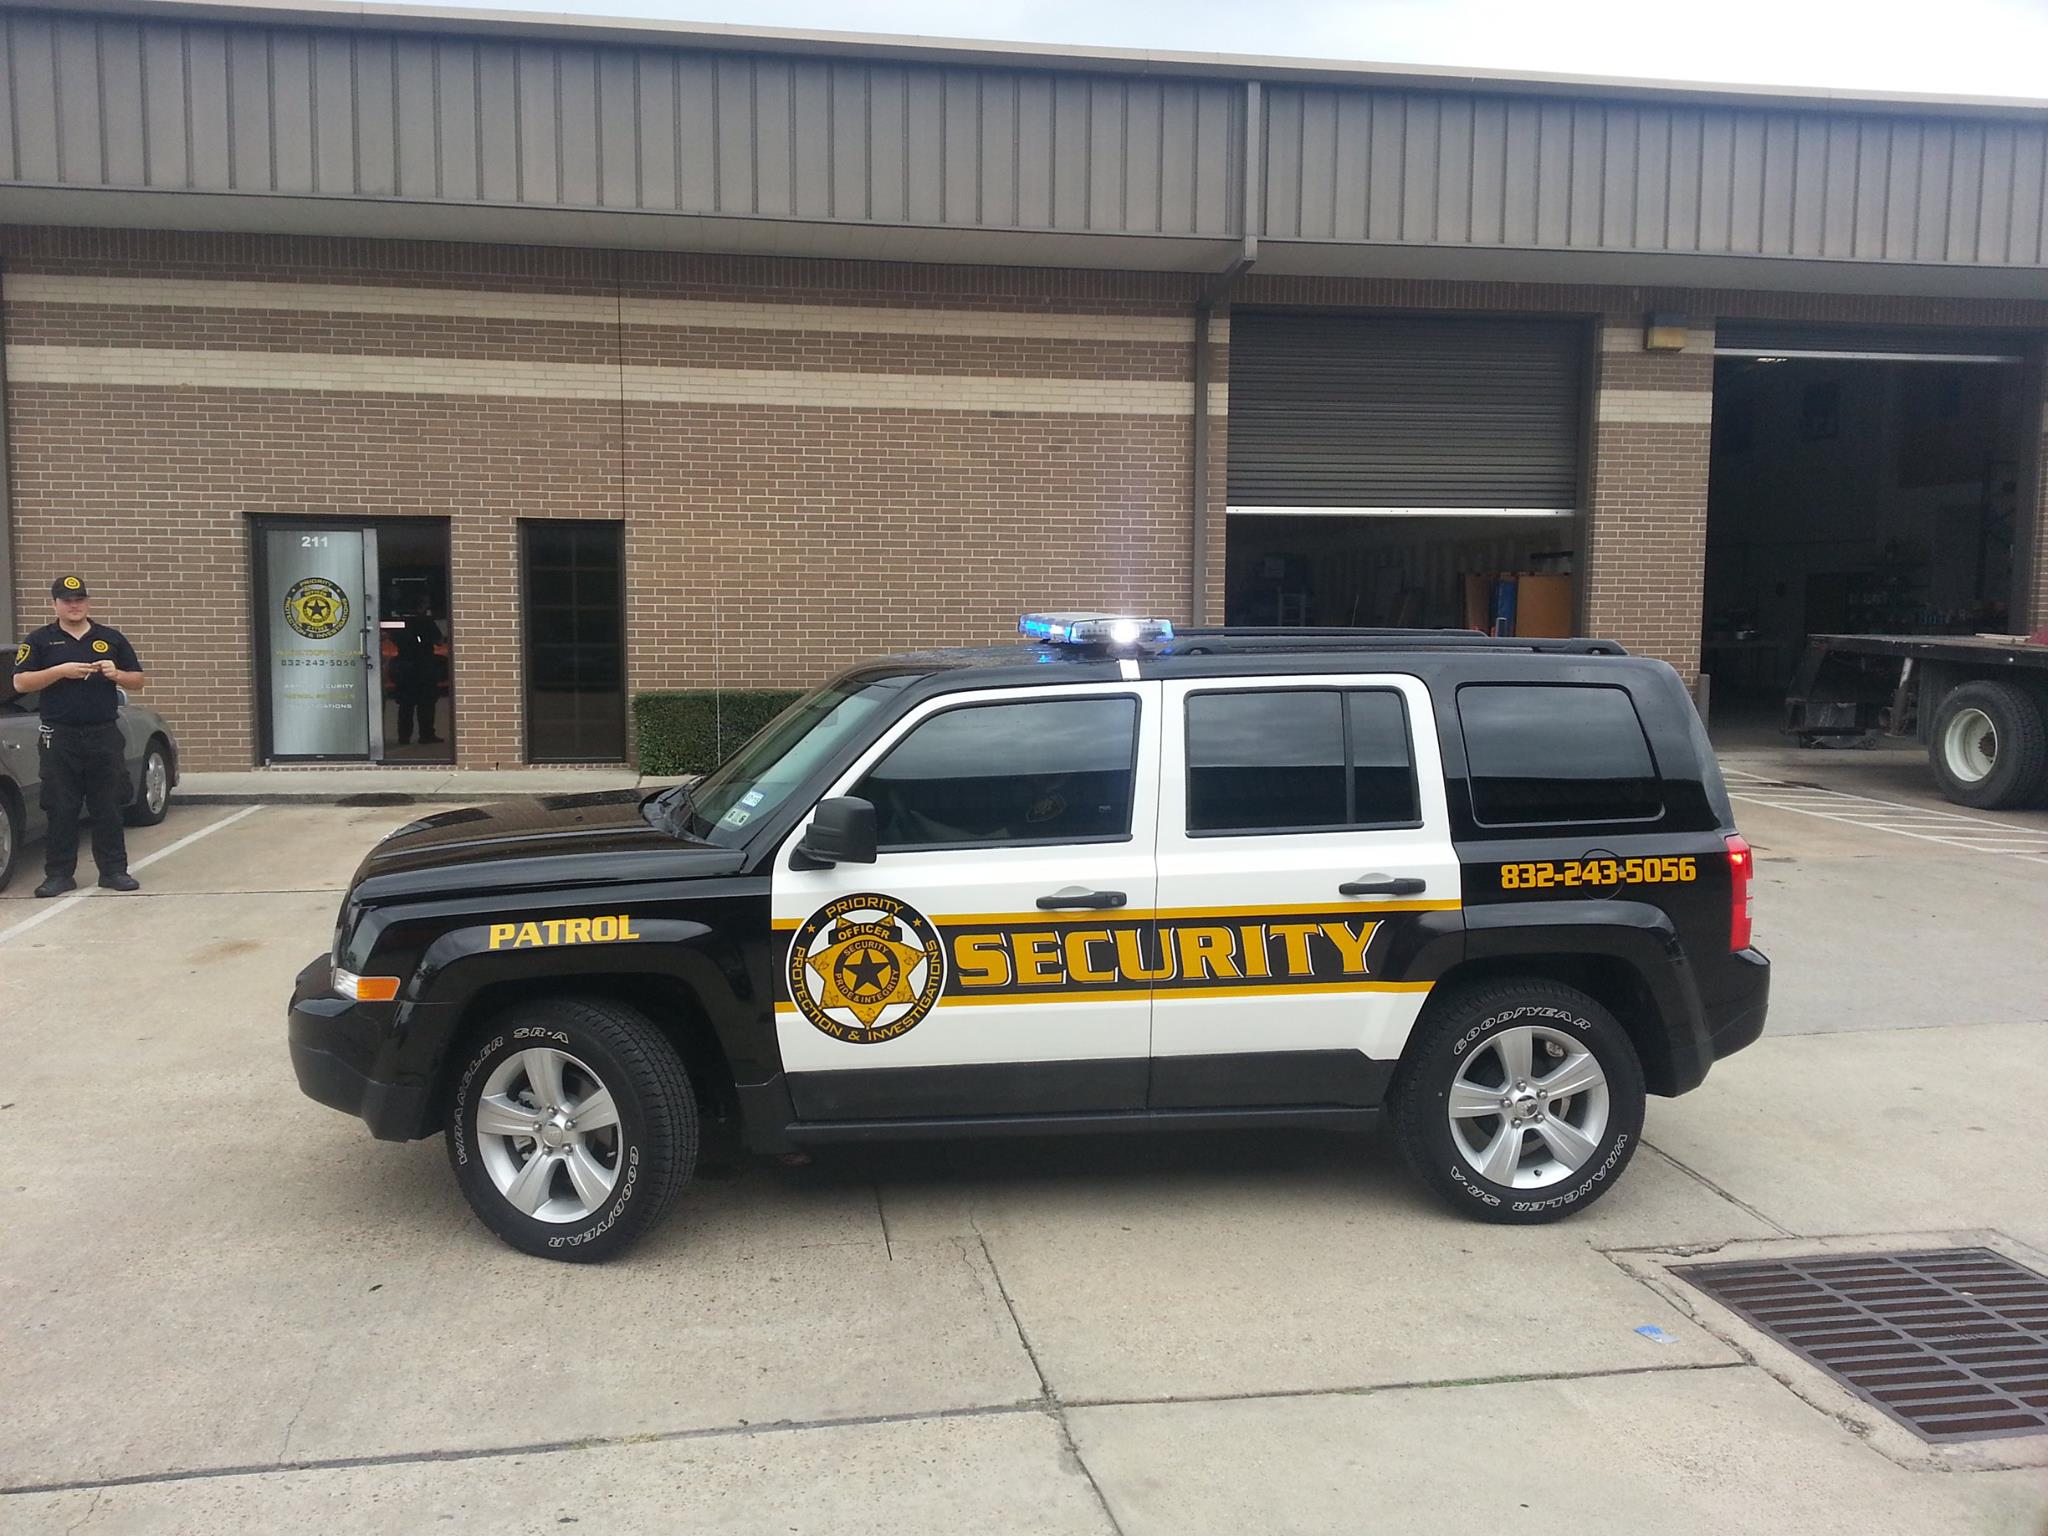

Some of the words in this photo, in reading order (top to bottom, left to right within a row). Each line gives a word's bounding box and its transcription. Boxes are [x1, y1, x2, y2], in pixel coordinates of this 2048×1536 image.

[301, 535, 329, 548] 211
[299, 578, 334, 587] PRIORITY
[1500, 857, 1697, 889] 832-243-5056
[825, 897, 903, 919] PRIORITY
[488, 914, 640, 950] PATROL
[837, 925, 891, 941] OFFICER
[843, 943, 889, 957] SECURITY
[953, 920, 1386, 988] SECURITY
[791, 946, 843, 1036] PROTECTION
[847, 1031, 861, 1041] &
[868, 939, 942, 1041] INVESTIGATIONS
[1453, 1006, 1592, 1055] GOODYEAR
[452, 1036, 504, 1165] WRANGLER
[1512, 1134, 1628, 1212] WRANGLER
[548, 1146, 640, 1248] GOODYEAR
